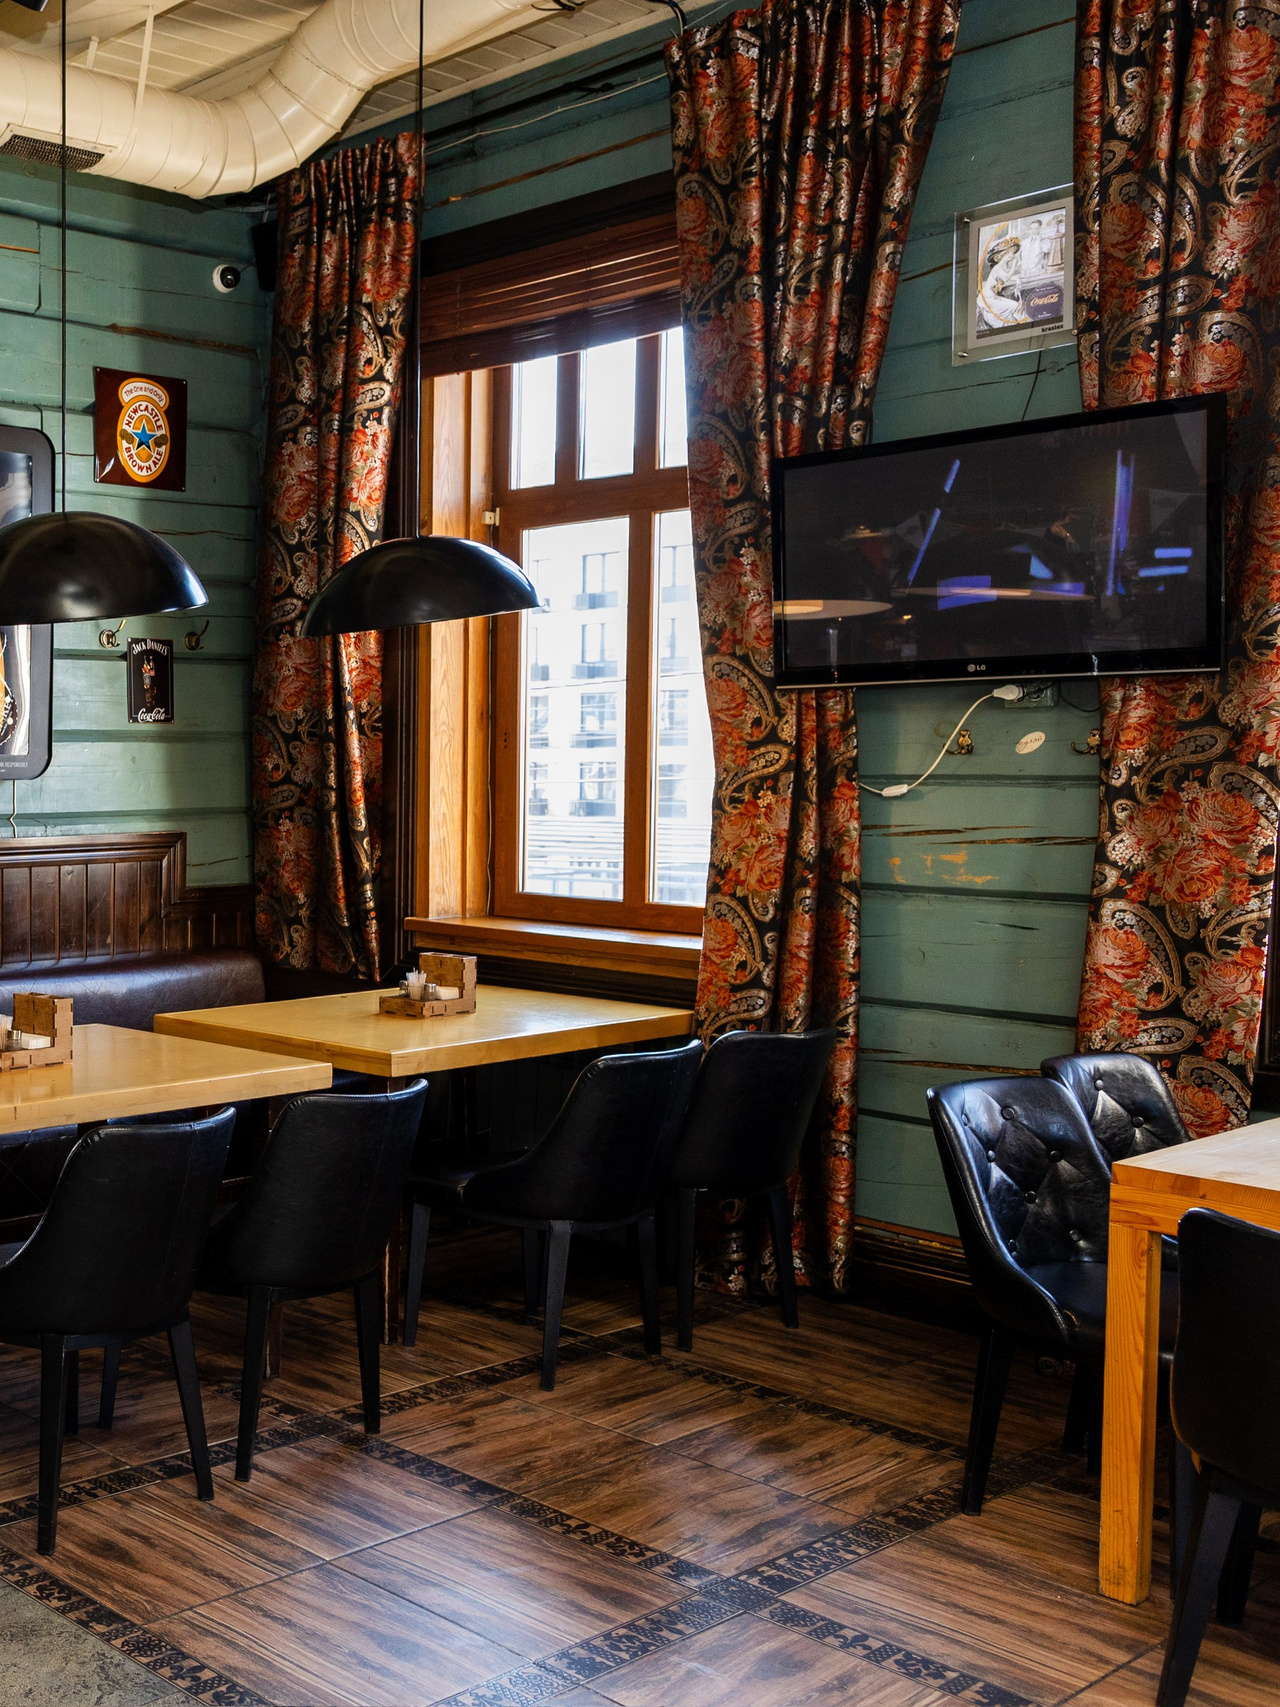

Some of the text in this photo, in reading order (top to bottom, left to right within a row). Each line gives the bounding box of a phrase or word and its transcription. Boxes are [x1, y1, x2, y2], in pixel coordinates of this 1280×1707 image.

[124, 388, 134, 397] The
[133, 385, 144, 393] One
[125, 403, 164, 432] NEWCASTLE
[125, 446, 164, 474] BROWN ALE
[132, 638, 168, 656] JACK DANIEL'S
